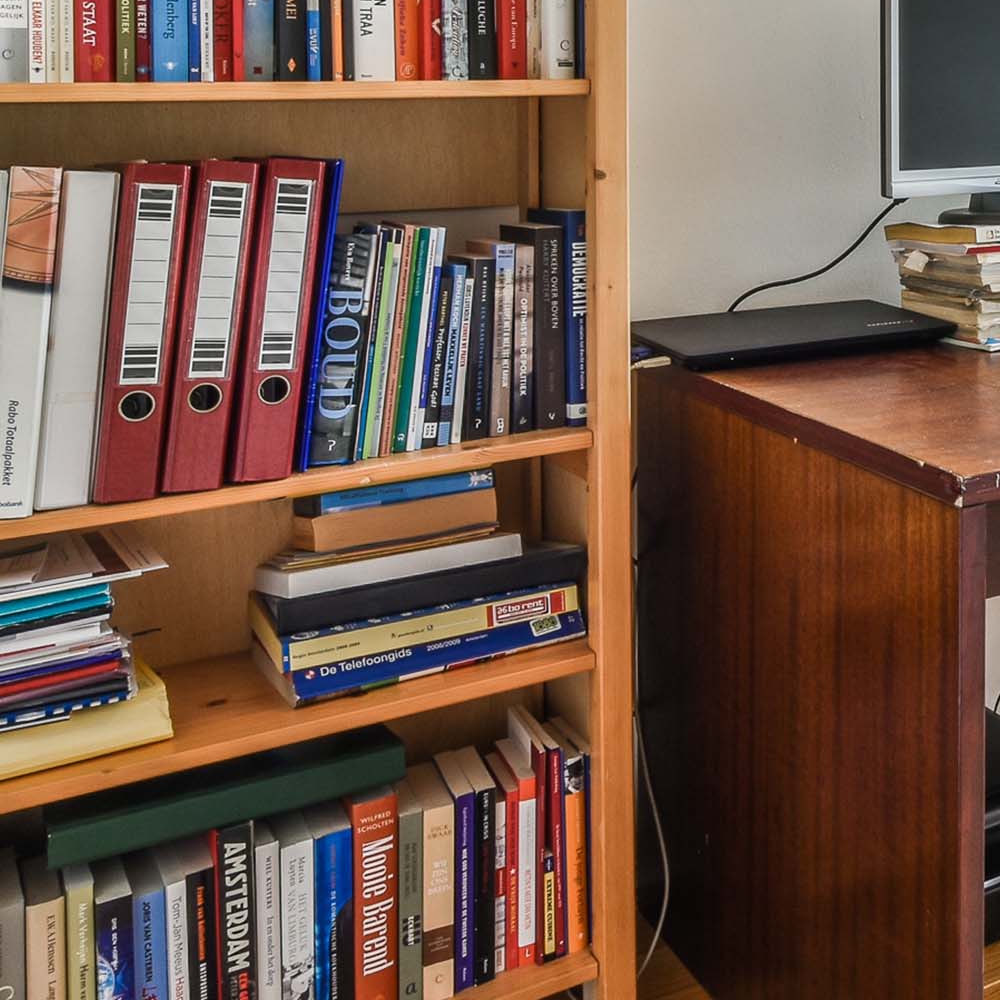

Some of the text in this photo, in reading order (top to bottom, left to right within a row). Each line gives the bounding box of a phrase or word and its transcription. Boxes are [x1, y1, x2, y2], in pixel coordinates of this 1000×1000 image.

[32, 1, 43, 28] ELKAAR
[82, 1, 96, 46] STAAT
[138, 3, 147, 39] WETEN?
[360, 8, 372, 36] TRAA
[32, 30, 44, 64] HOUDEN?
[346, 242, 355, 256] Eva
[550, 240, 560, 329] SPREKEN OVER BOVEN
[572, 242, 587, 317] DEMOCRATIE
[318, 287, 364, 420] BOUD
[434, 328, 446, 363] Professor,
[444, 274, 463, 397] HERMAN KOCH MAKKELIJK LEVEN
[520, 298, 528, 396] OPTIMIST IN DE POLITIEK
[2, 400, 20, 486] Rabo Totaalpakket
[522, 599, 545, 610] rent
[320, 666, 338, 678] De
[340, 648, 413, 672] Telefoongids
[357, 818, 394, 834] SCHOLTEN
[360, 810, 392, 824] WILFRED
[224, 842, 250, 973] AMSTERDAM
[287, 890, 297, 963] VAN LIMBURG
[298, 892, 307, 952] HET GELUK
[362, 834, 394, 976] Mooie Barend
[142, 902, 152, 982] JORIS VAN CASTEREN
[170, 896, 183, 976] Tom-Jan Meeus
[80, 964, 90, 988] Harm
